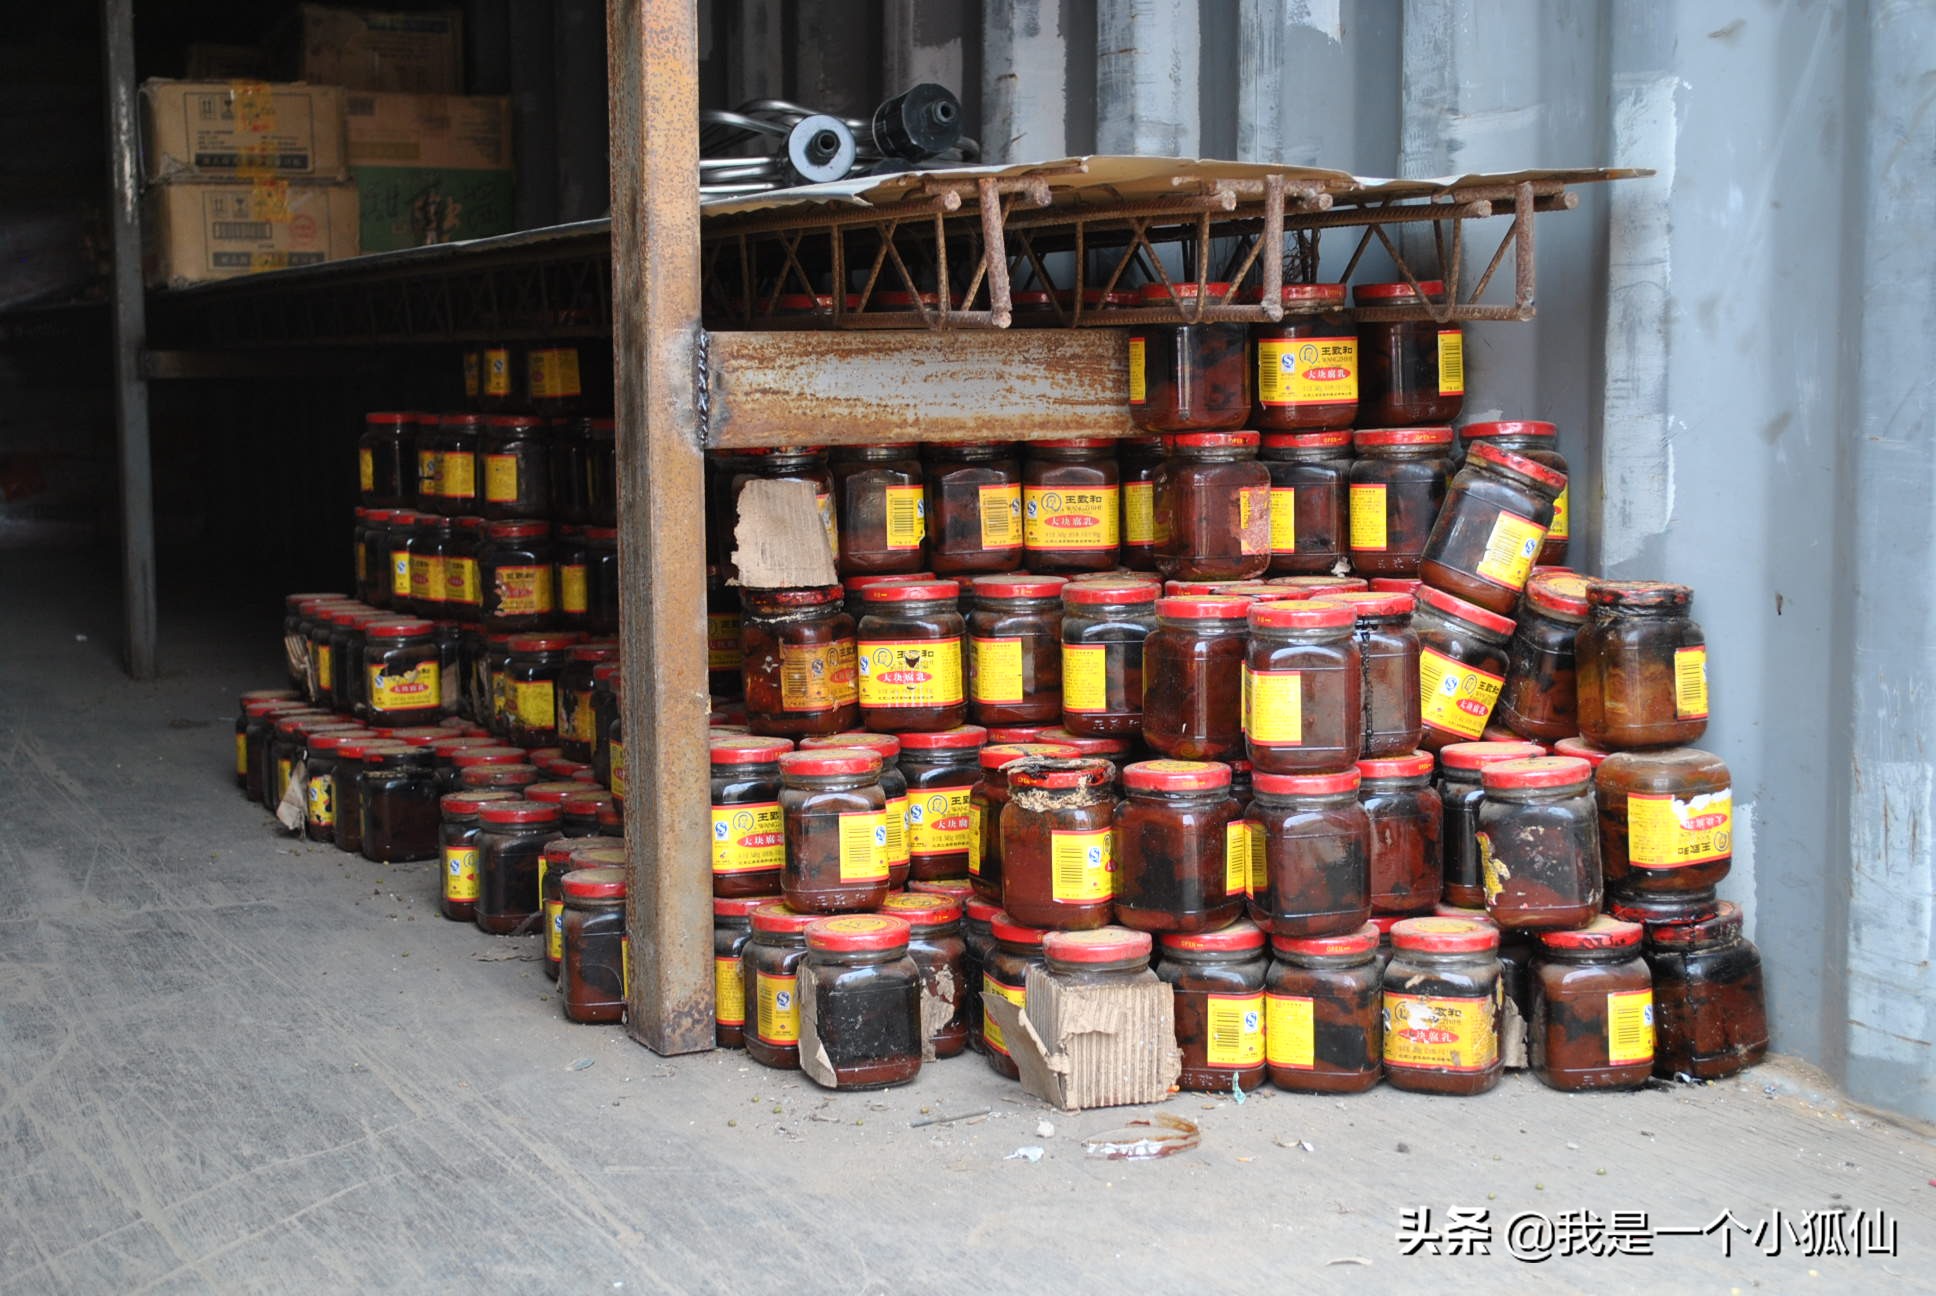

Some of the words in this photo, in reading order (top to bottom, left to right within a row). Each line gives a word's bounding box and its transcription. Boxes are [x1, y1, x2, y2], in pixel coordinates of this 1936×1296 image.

[1308, 369, 1346, 379] 大块腐乳
[1051, 516, 1093, 526] 大块腐乳
